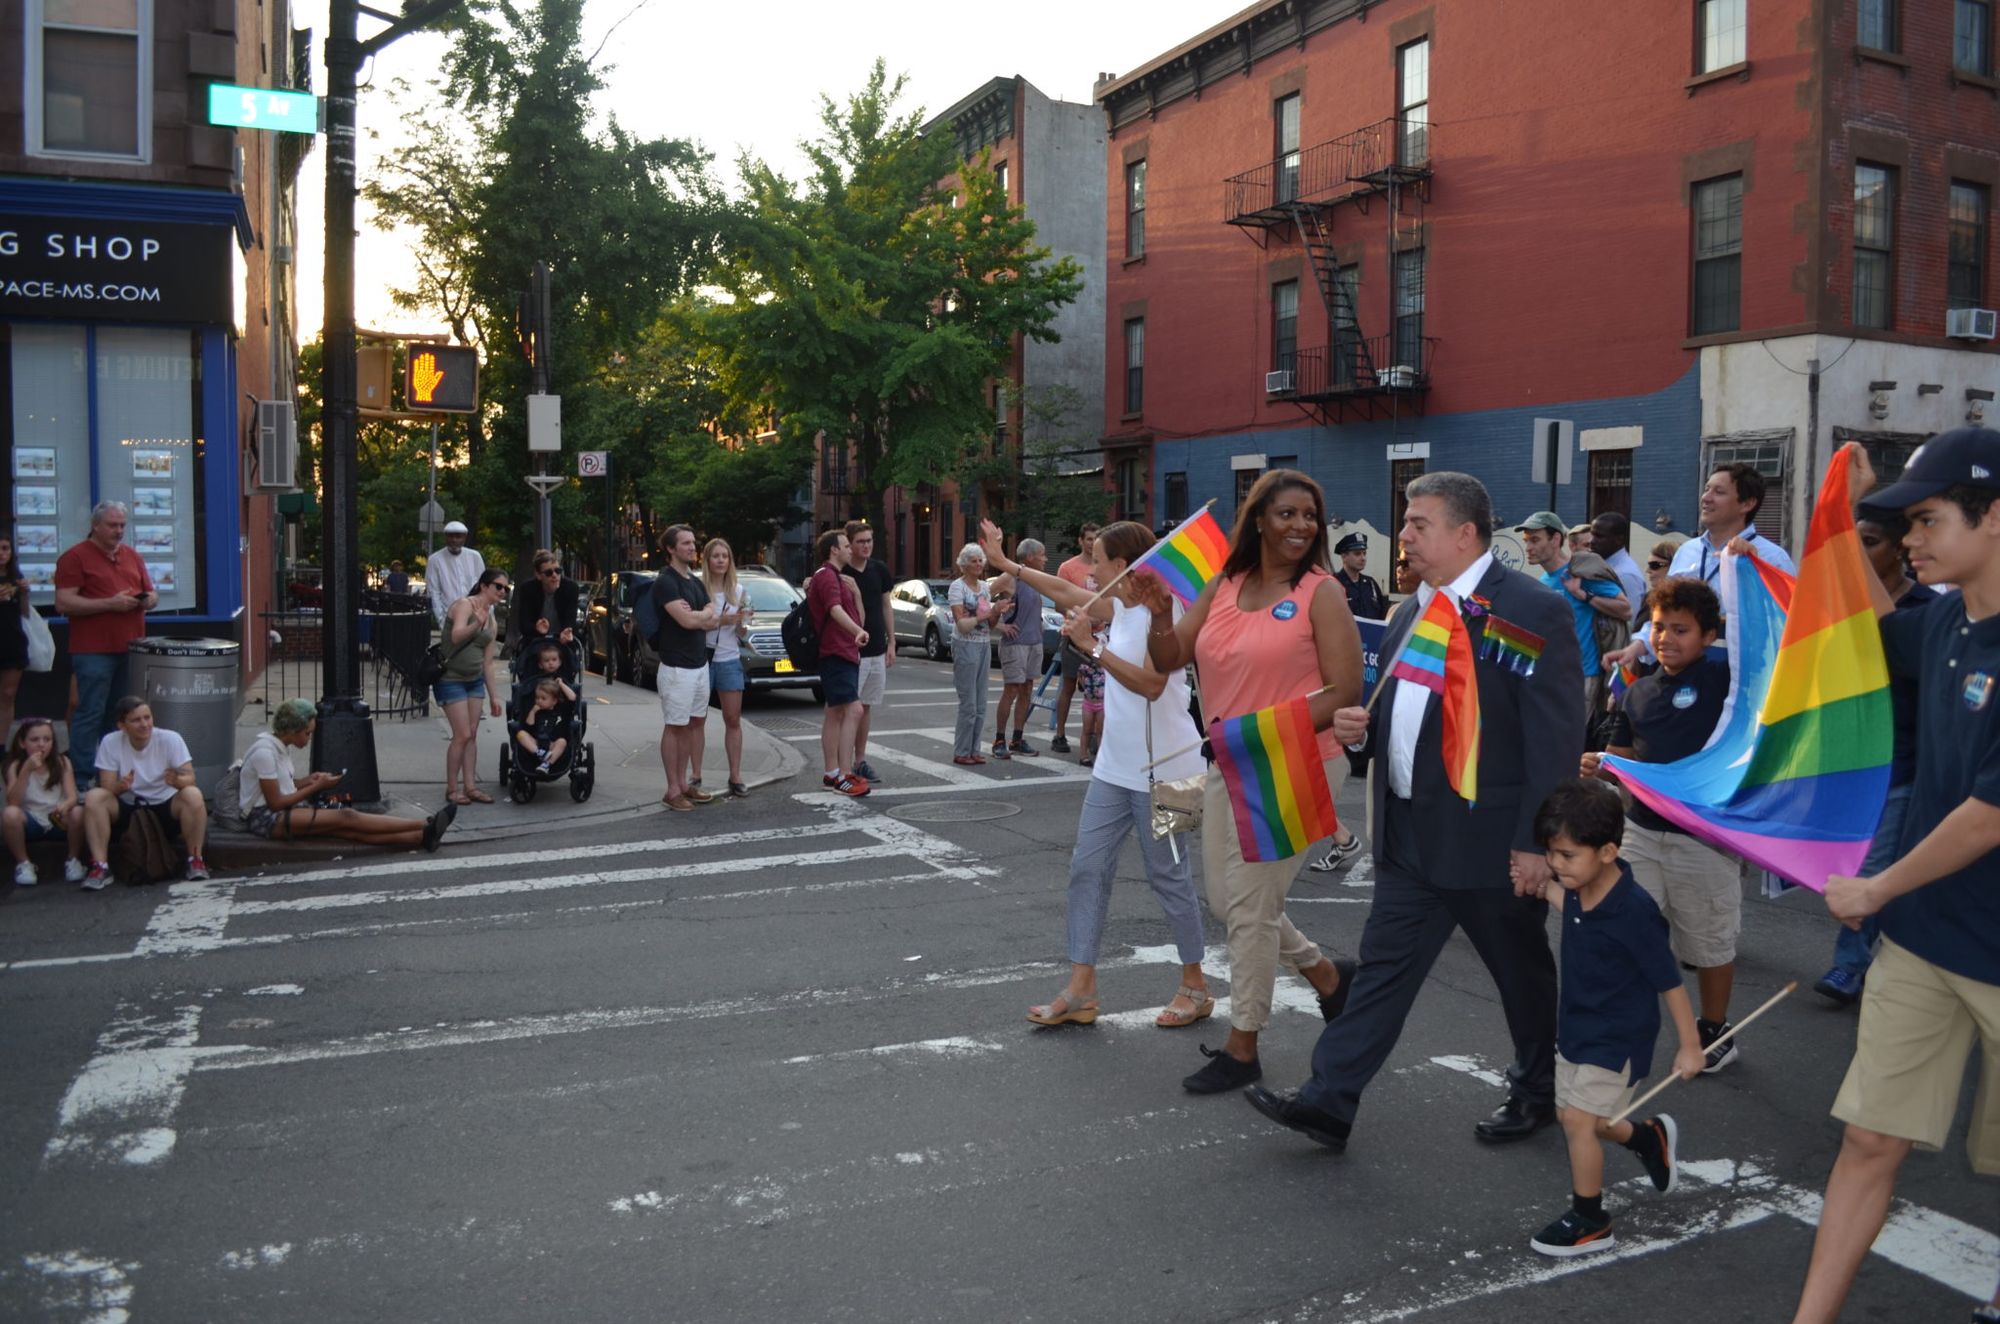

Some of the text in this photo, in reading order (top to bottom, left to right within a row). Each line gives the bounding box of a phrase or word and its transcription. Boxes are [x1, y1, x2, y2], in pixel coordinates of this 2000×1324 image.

[241, 92, 256, 122] 5
[47, 233, 161, 262] SHOP
[167, 648, 188, 656] Don't
